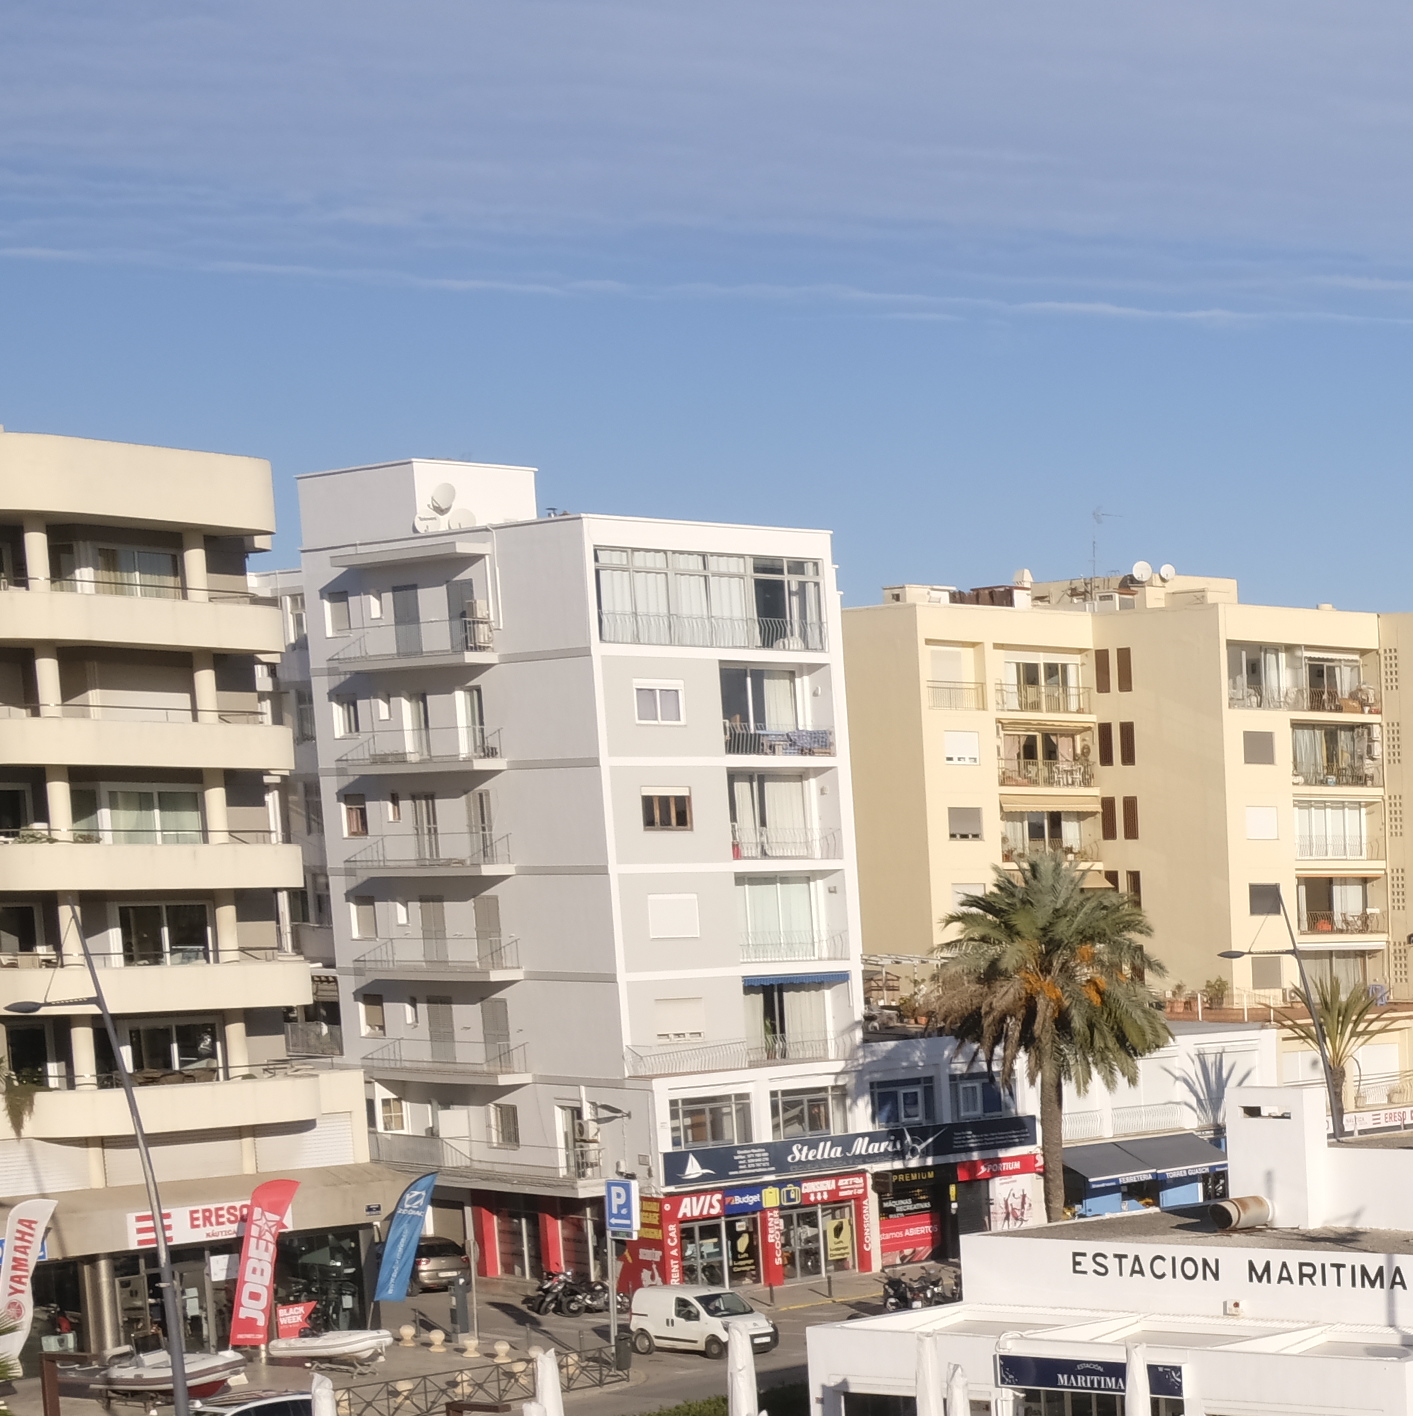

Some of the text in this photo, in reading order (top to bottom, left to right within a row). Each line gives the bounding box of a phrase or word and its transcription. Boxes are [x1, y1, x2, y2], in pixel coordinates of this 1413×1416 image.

[1384, 1111, 1407, 1123] ERESO
[787, 1141, 843, 1163] Stella
[892, 1171, 934, 1182] PREMIUM
[610, 1186, 626, 1214] P
[677, 1193, 723, 1218] AVIS
[734, 1194, 760, 1205] Budget
[189, 1203, 252, 1229] ERESO
[767, 1211, 775, 1243] RENT
[863, 1198, 871, 1251] CONSIGNA
[880, 1225, 938, 1240] stamos ABIERTOS
[8, 1218, 39, 1297] YAMAHA
[667, 1223, 680, 1285] RENT A CAR
[239, 1236, 276, 1327] JOBE
[1072, 1251, 1409, 1291] ESTACION MARITIMA
[278, 1306, 305, 1317] BLACK
[279, 1315, 303, 1325] WEEK
[1057, 1373, 1125, 1390] MARITIMA
